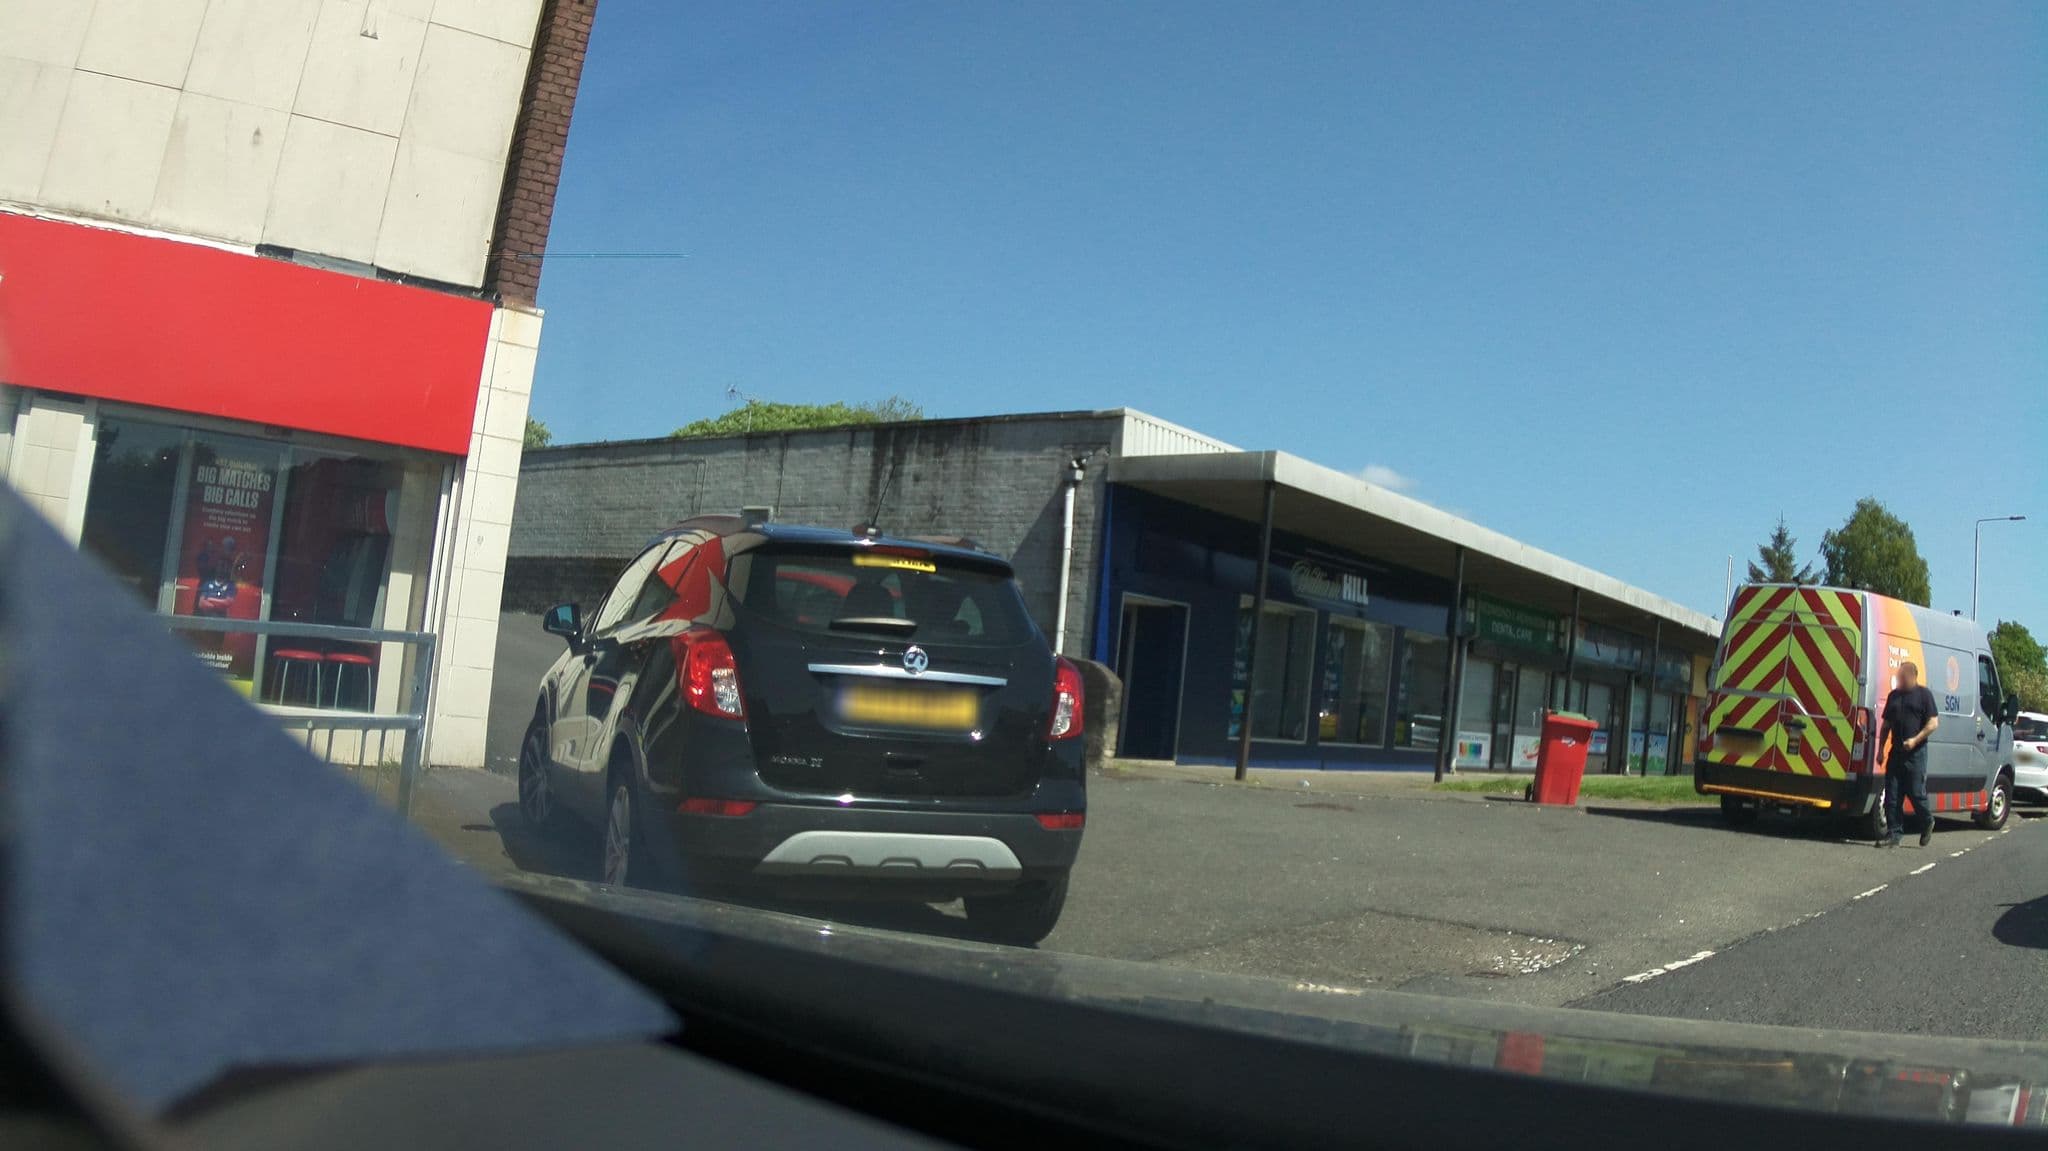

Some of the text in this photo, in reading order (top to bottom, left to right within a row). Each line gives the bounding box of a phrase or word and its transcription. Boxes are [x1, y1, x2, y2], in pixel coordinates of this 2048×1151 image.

[197, 465, 271, 492] BIG MATCHES
[203, 485, 260, 509] BIG CALLS
[1342, 572, 1369, 605] HILL
[1945, 694, 1960, 713] SGN
